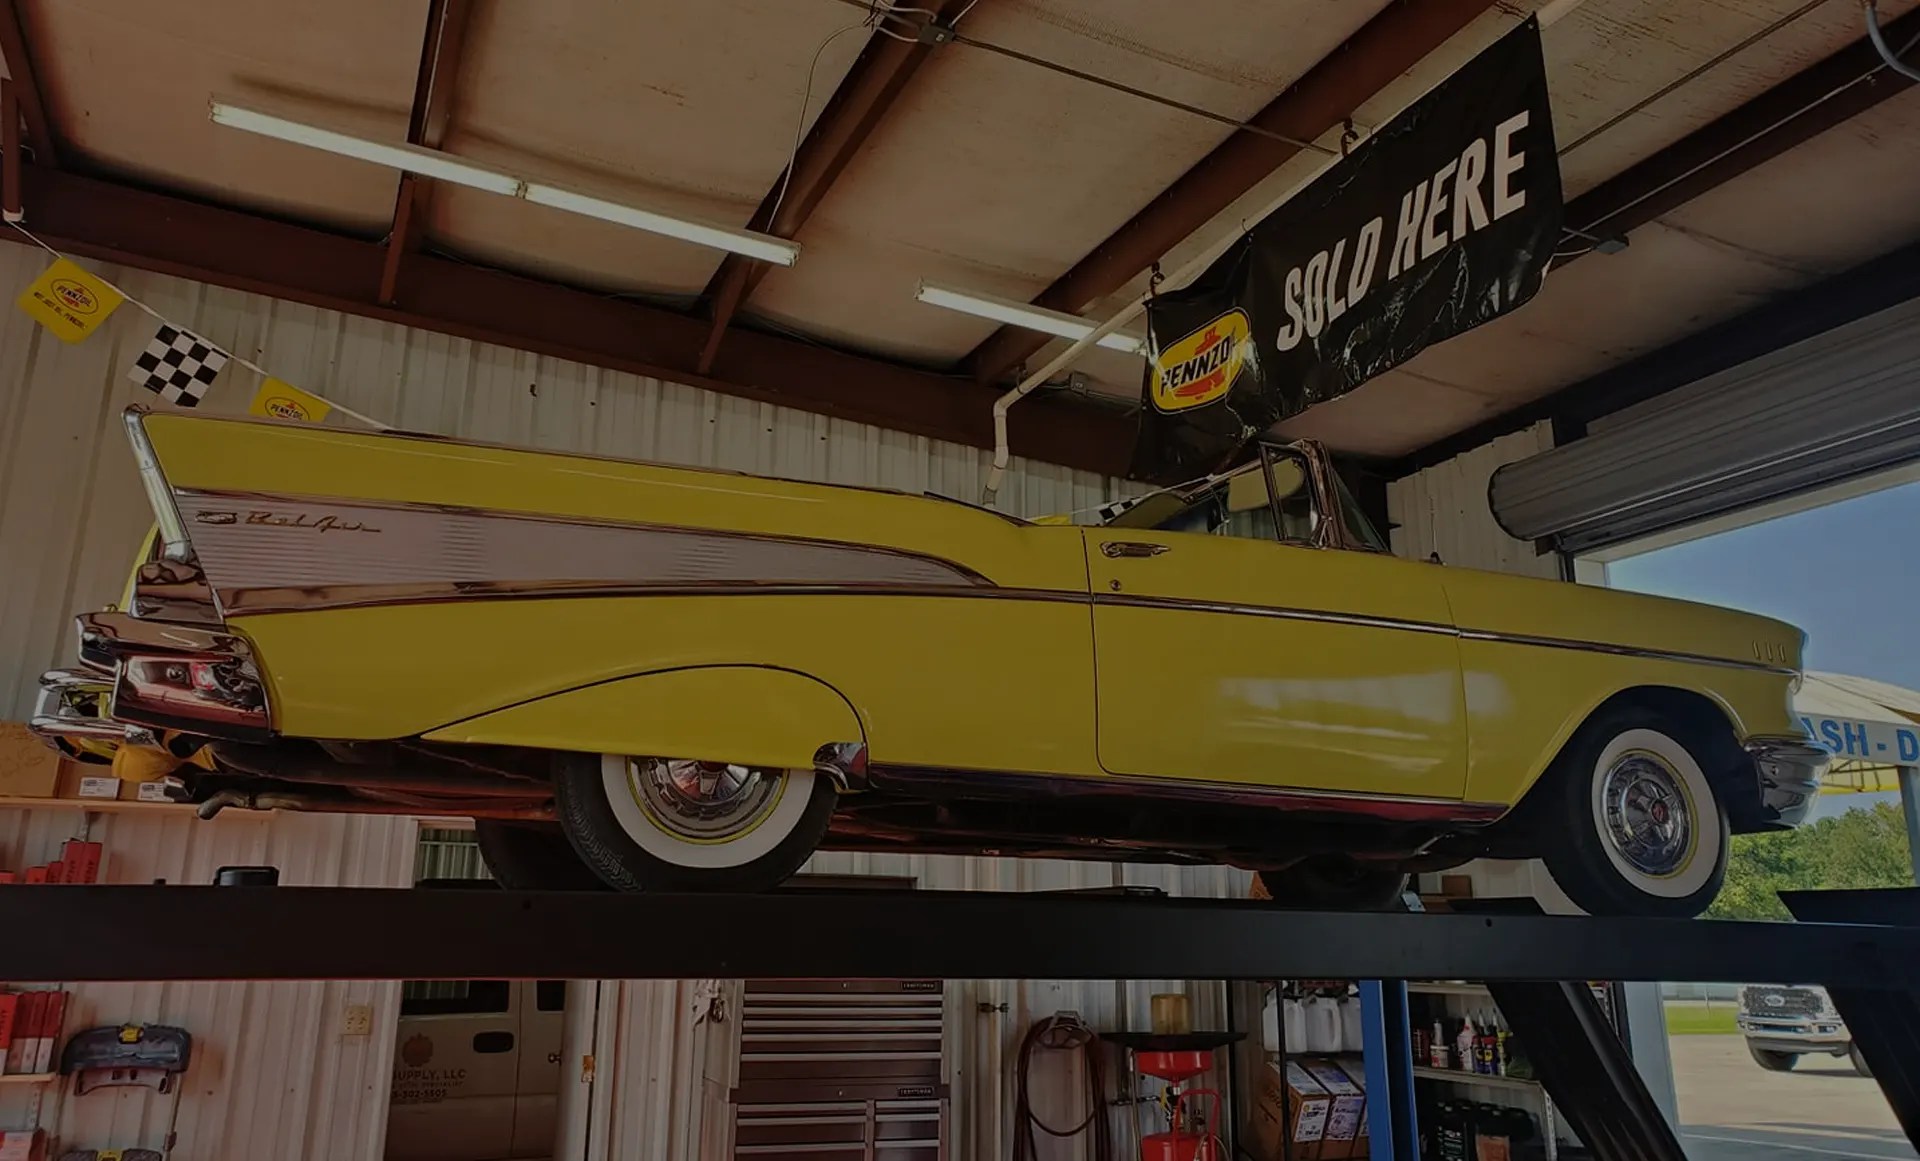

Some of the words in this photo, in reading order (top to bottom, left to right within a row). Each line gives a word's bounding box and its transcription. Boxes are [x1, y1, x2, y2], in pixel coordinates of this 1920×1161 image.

[1276, 216, 1383, 352] SOLD
[1388, 109, 1530, 281] HERE
[1160, 335, 1234, 398] PENNZO
